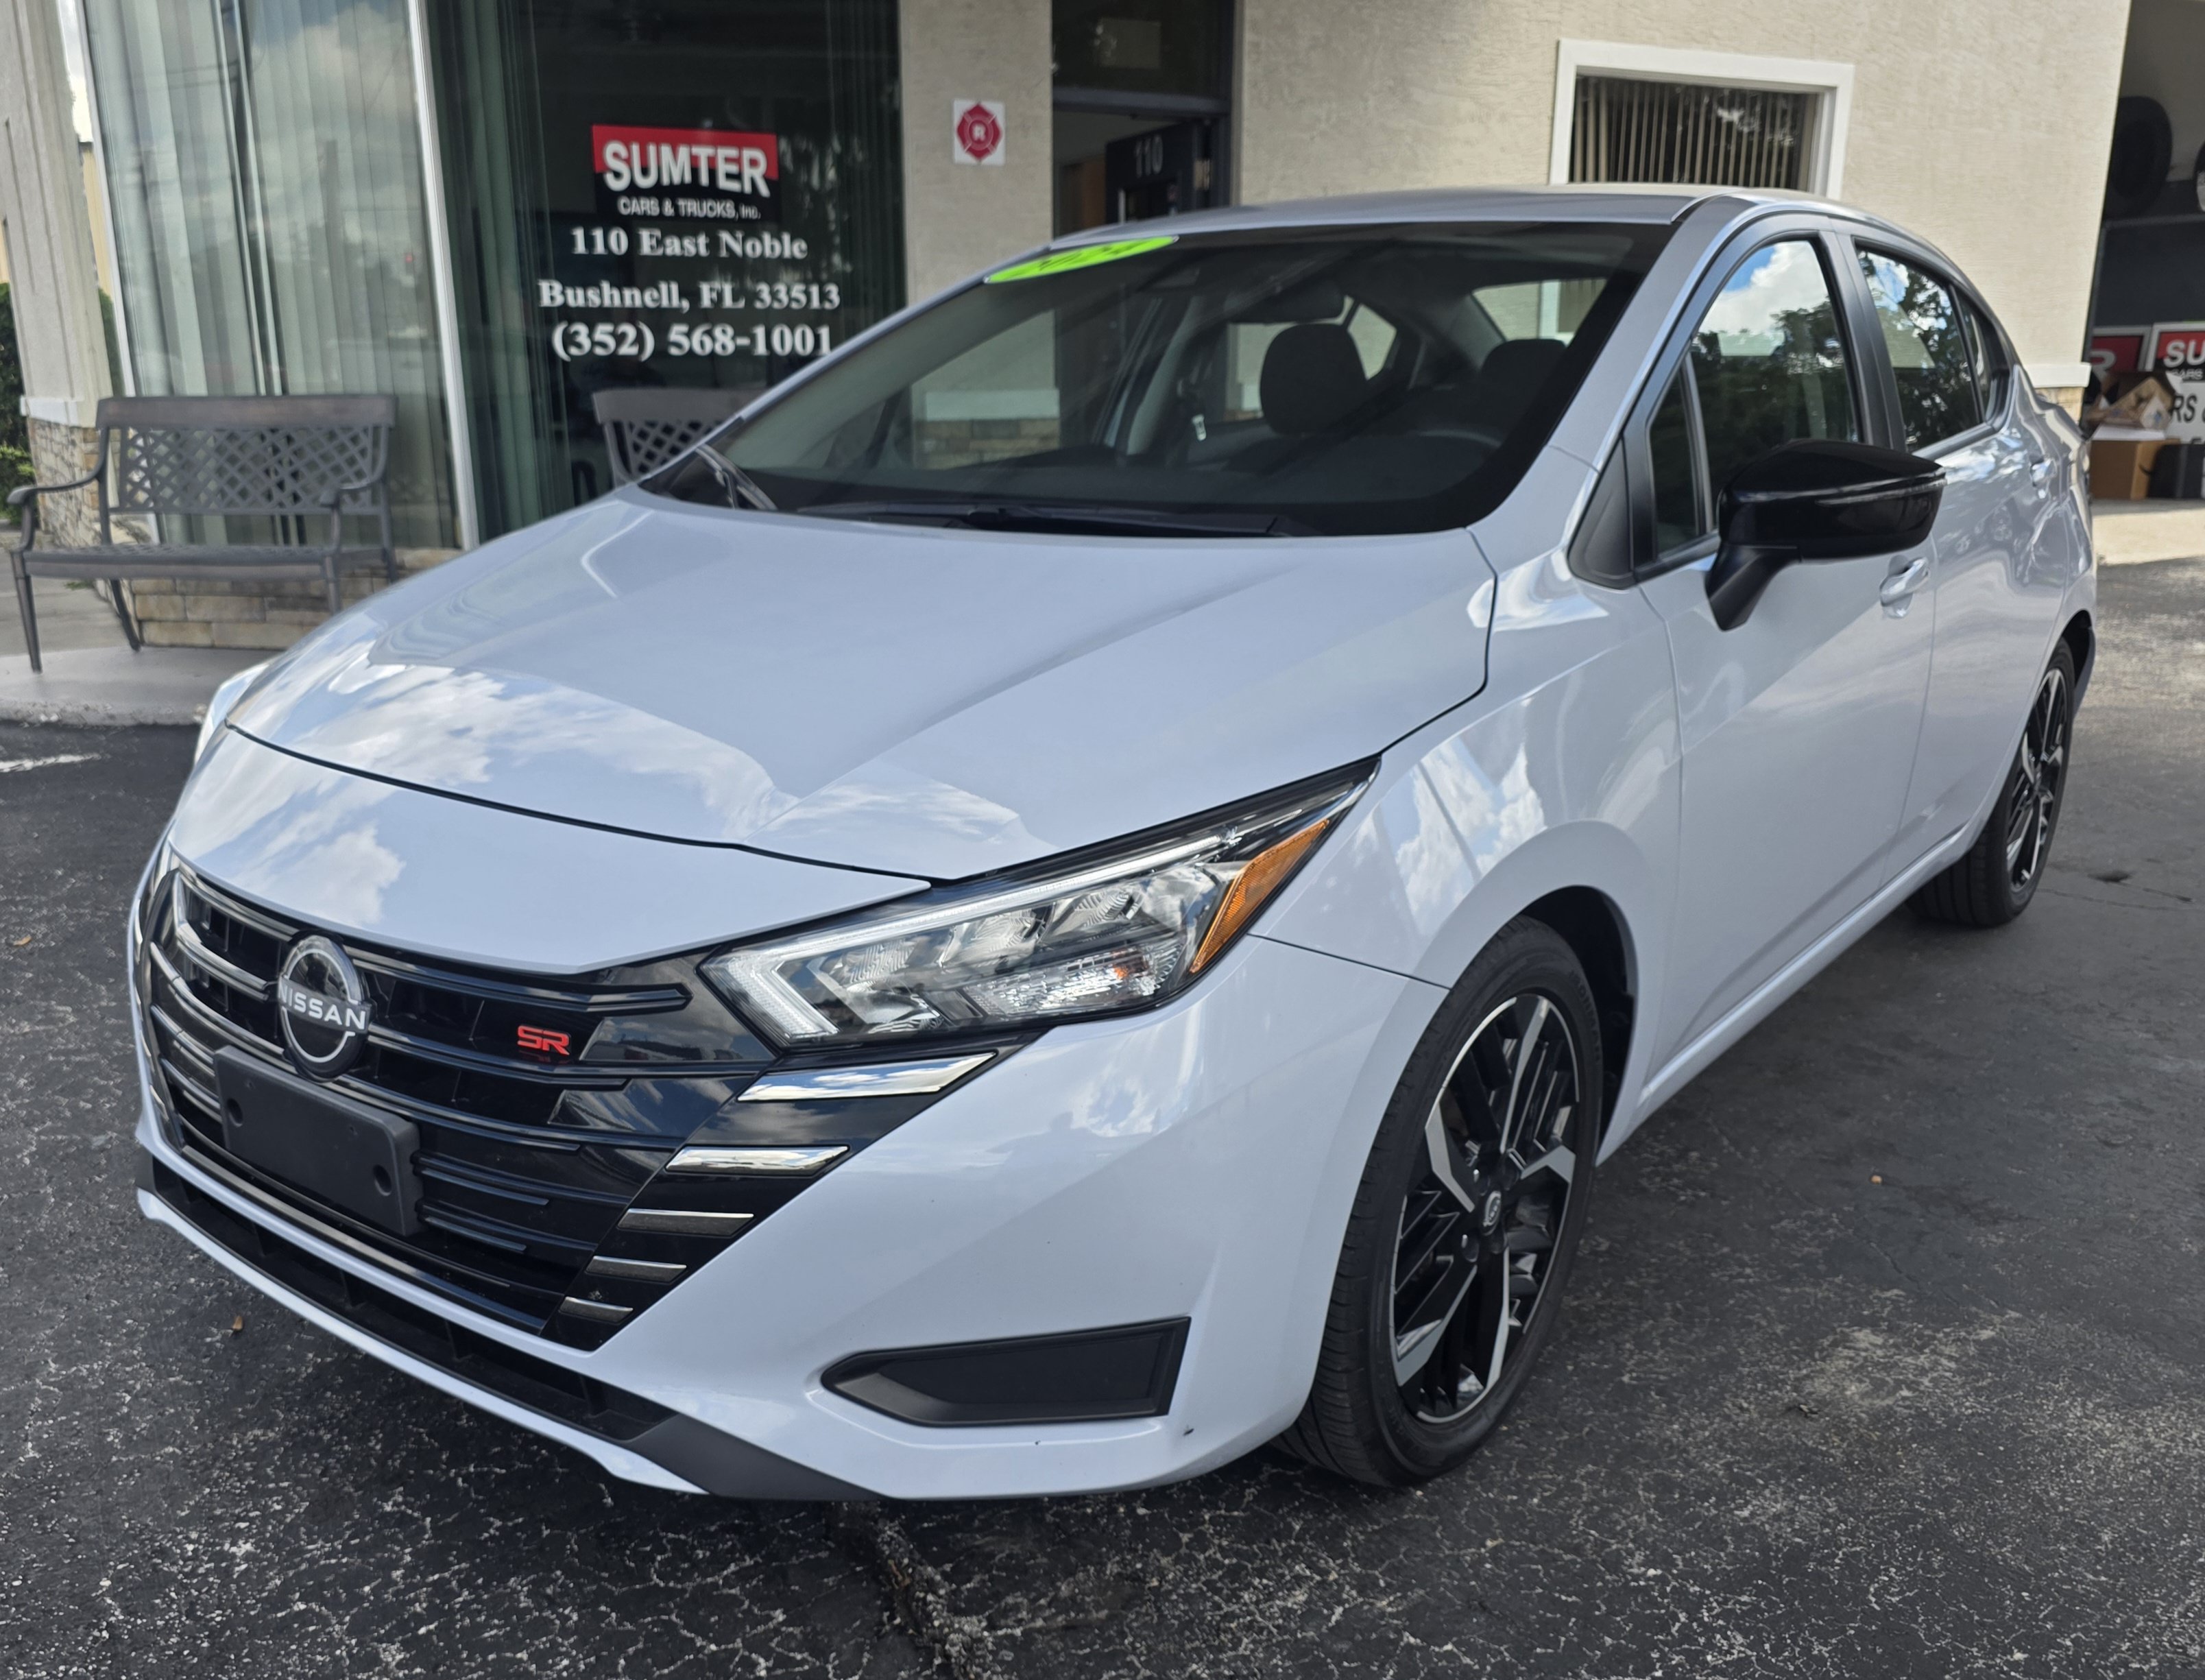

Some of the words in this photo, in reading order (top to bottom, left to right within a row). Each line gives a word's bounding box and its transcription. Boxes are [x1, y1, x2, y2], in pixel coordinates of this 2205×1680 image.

[603, 139, 771, 197] SUMTER
[1135, 135, 1164, 178] 110
[618, 195, 660, 217] CARS
[662, 197, 675, 217] &
[572, 227, 629, 256] 110
[637, 228, 710, 257] East
[717, 230, 808, 260] Noble
[538, 278, 690, 313] Bushnell,
[699, 281, 746, 309] FL
[754, 282, 841, 310] 33513
[552, 320, 655, 362] (352)
[667, 323, 832, 357] 568-1001
[278, 979, 366, 1030] NISSAN
[517, 1025, 570, 1055] SR
